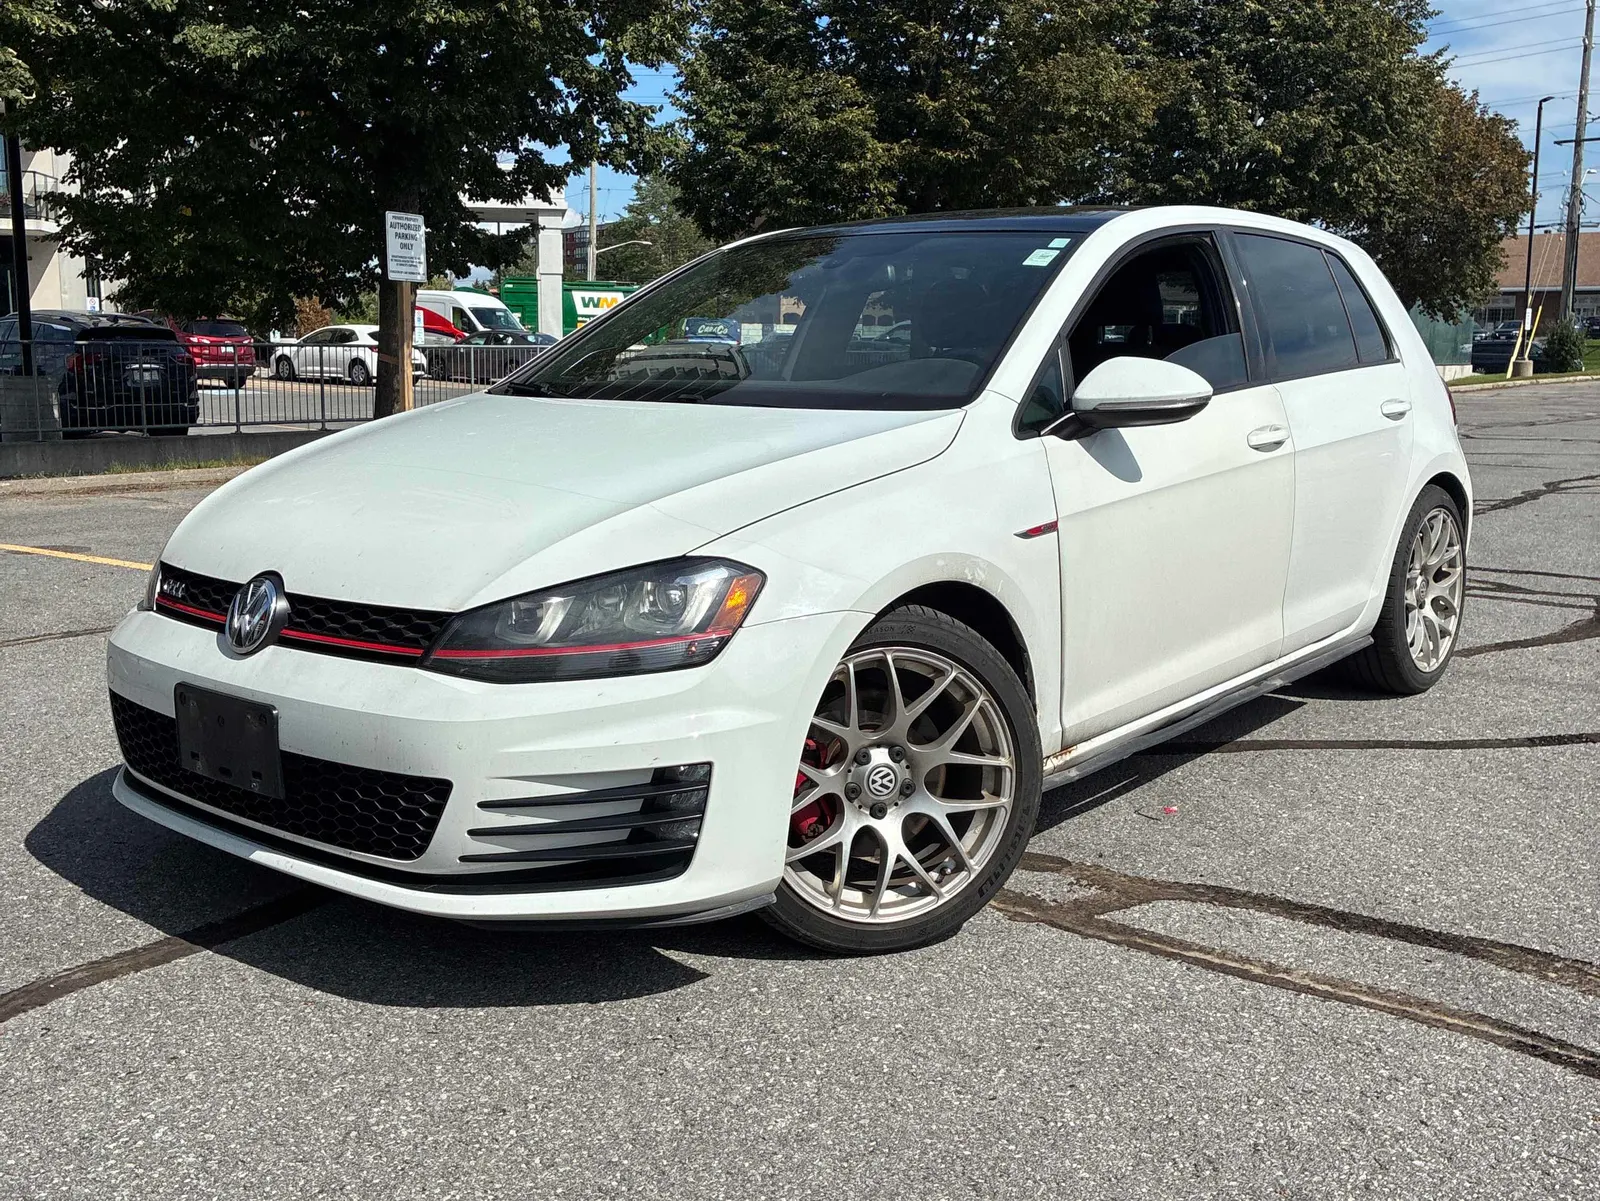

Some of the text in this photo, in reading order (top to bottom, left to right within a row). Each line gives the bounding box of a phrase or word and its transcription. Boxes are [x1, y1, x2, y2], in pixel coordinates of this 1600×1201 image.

[390, 221, 421, 231] AUTHORIZED
[394, 231, 418, 241] PARKING
[399, 242, 414, 251] ONLY
[581, 296, 618, 309] WM
